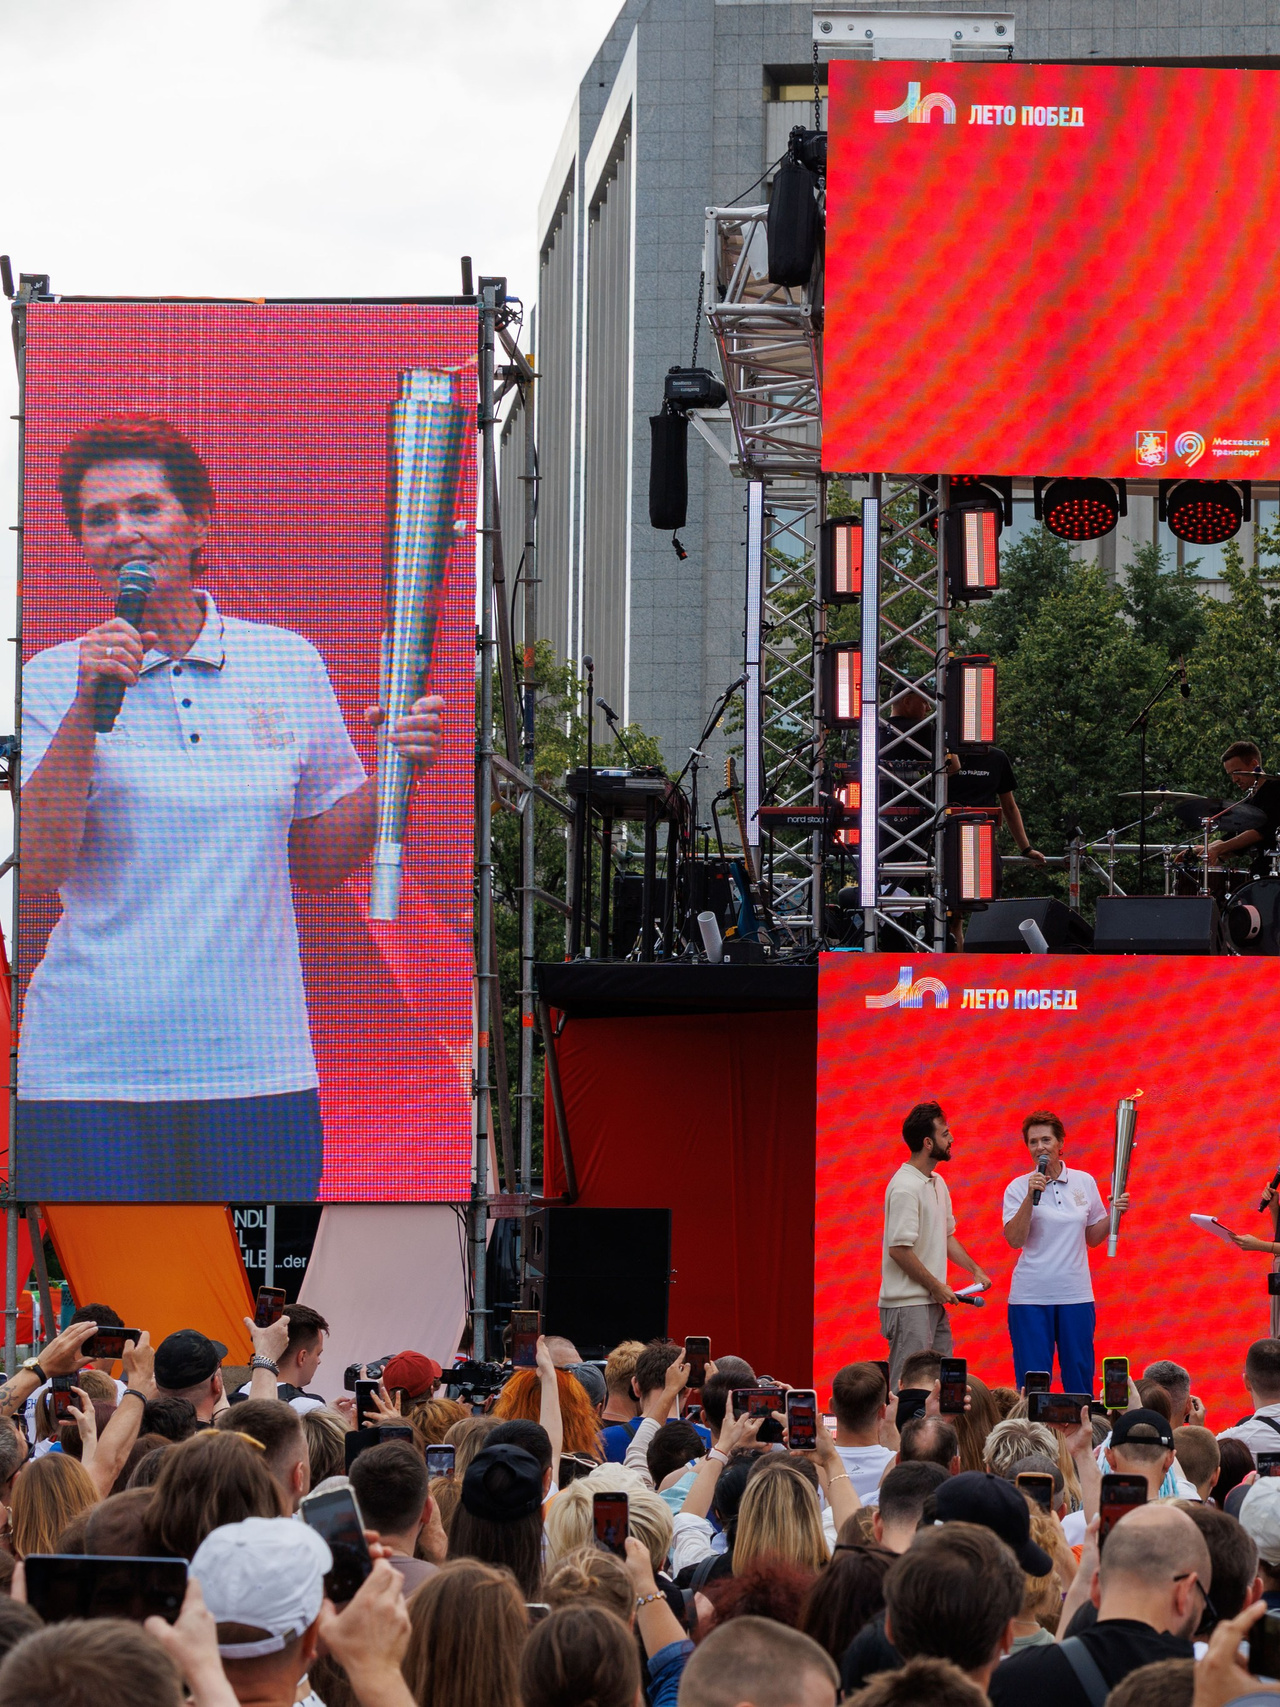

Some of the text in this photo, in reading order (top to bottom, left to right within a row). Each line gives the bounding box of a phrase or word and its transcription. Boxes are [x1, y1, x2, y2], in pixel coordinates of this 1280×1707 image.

[968, 104, 1085, 127] ЛЕТО ПОБЕД
[1212, 437, 1270, 446] Московский
[1212, 449, 1260, 458] транспорт
[807, 816, 829, 824] stag
[960, 988, 1078, 1010] ЛЕТО ПОБЕД
